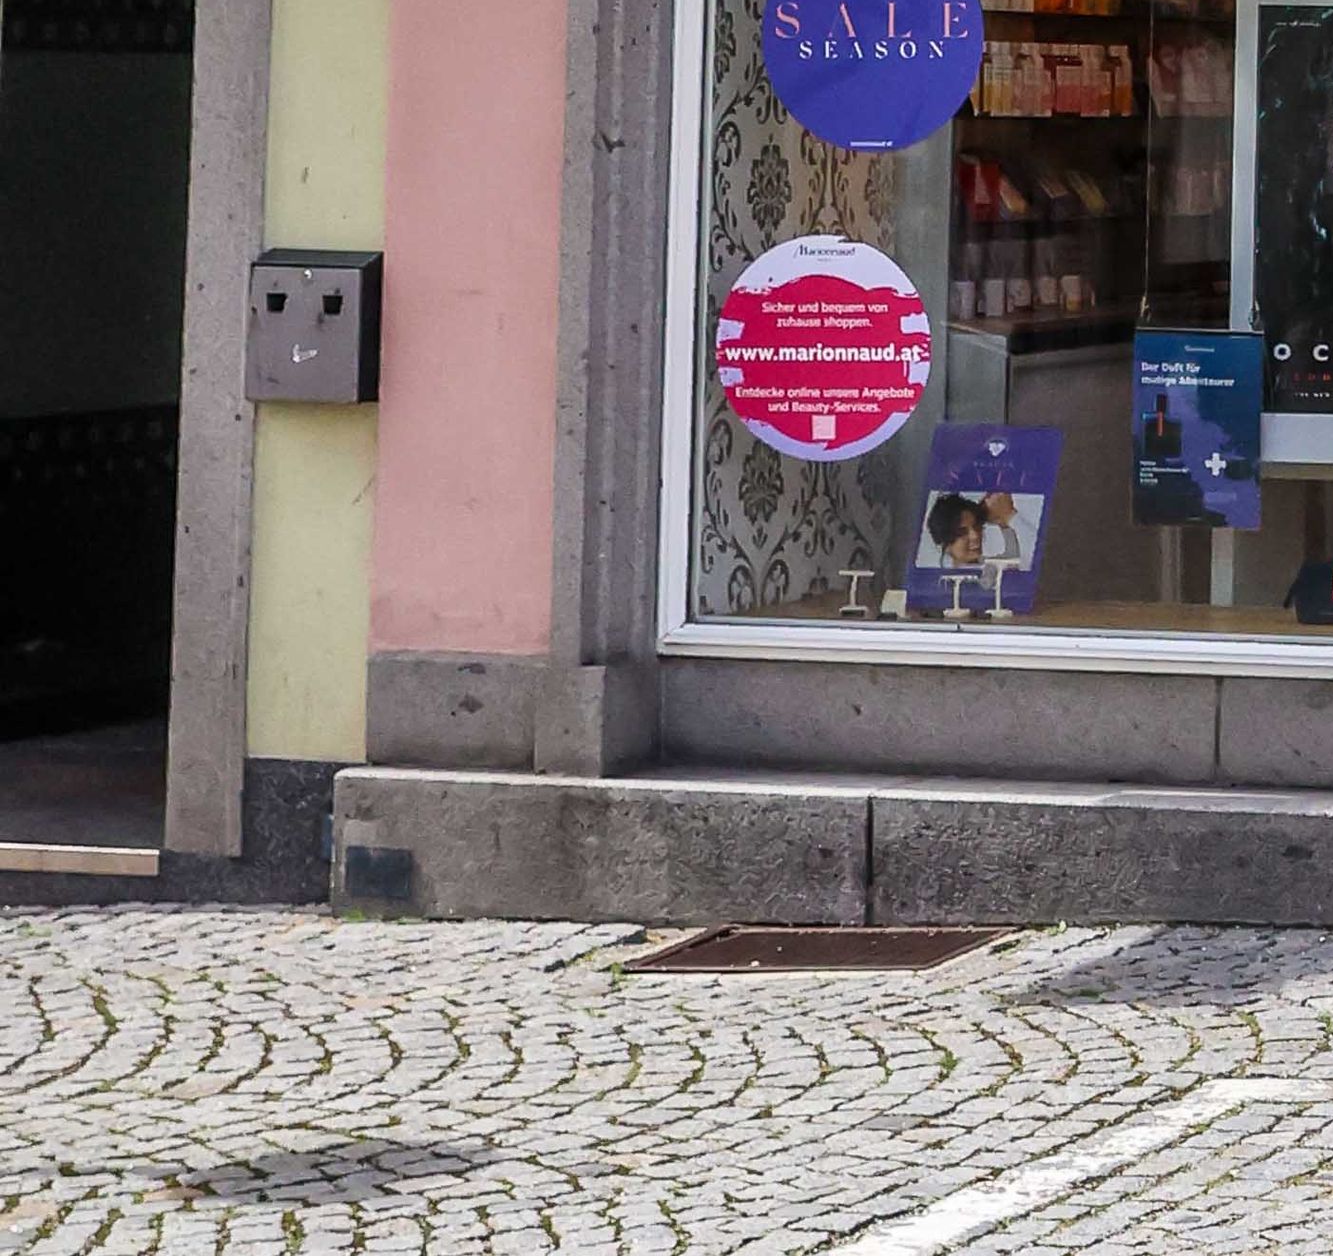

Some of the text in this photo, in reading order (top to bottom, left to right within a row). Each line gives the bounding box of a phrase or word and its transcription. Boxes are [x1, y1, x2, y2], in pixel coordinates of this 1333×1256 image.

[775, 2, 968, 38] SALE
[800, 41, 944, 59] SEASON
[762, 302, 888, 316] Sicher und bequem von
[777, 317, 873, 329] zuhause shoppen.
[725, 343, 920, 362] www.marionnaud.at
[1141, 362, 1159, 373] Der
[1161, 362, 1183, 373] Duft
[735, 387, 914, 401] Entdecke online unsere Angebote
[768, 402, 881, 414] und Beauty-Services.
